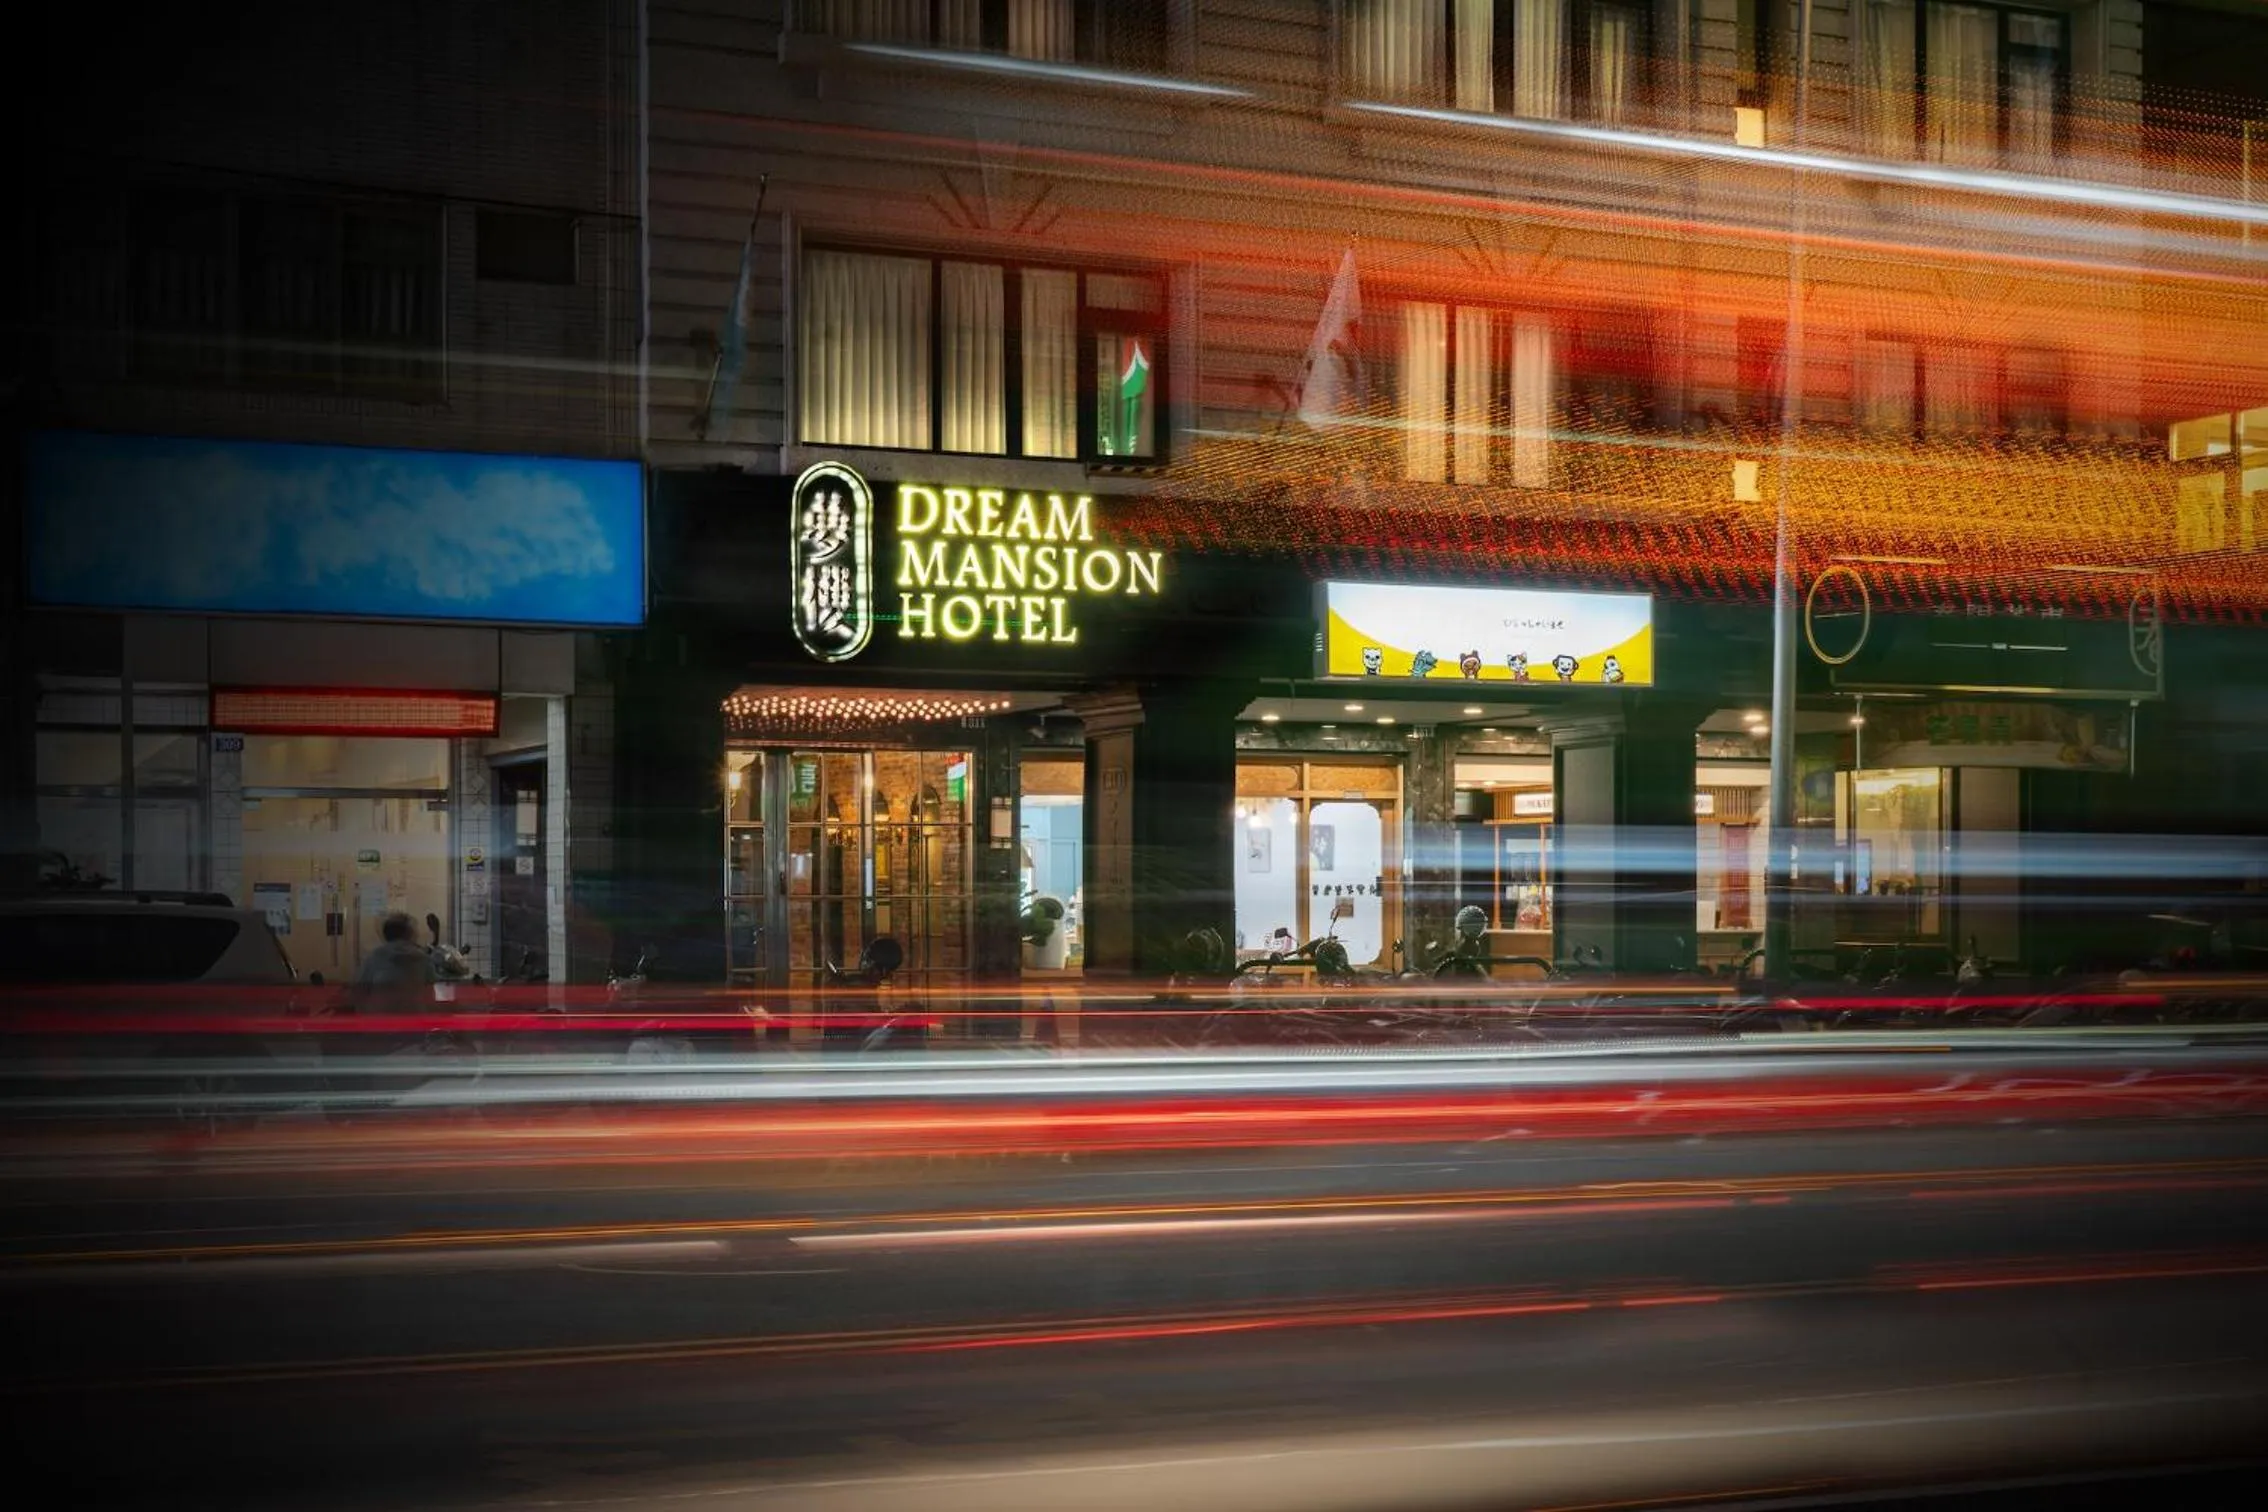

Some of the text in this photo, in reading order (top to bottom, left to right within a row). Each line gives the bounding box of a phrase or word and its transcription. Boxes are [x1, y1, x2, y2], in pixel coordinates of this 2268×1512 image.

[898, 484, 1094, 541] DREAM
[897, 540, 1162, 595] MANSION
[898, 592, 1078, 643] HOTEL
